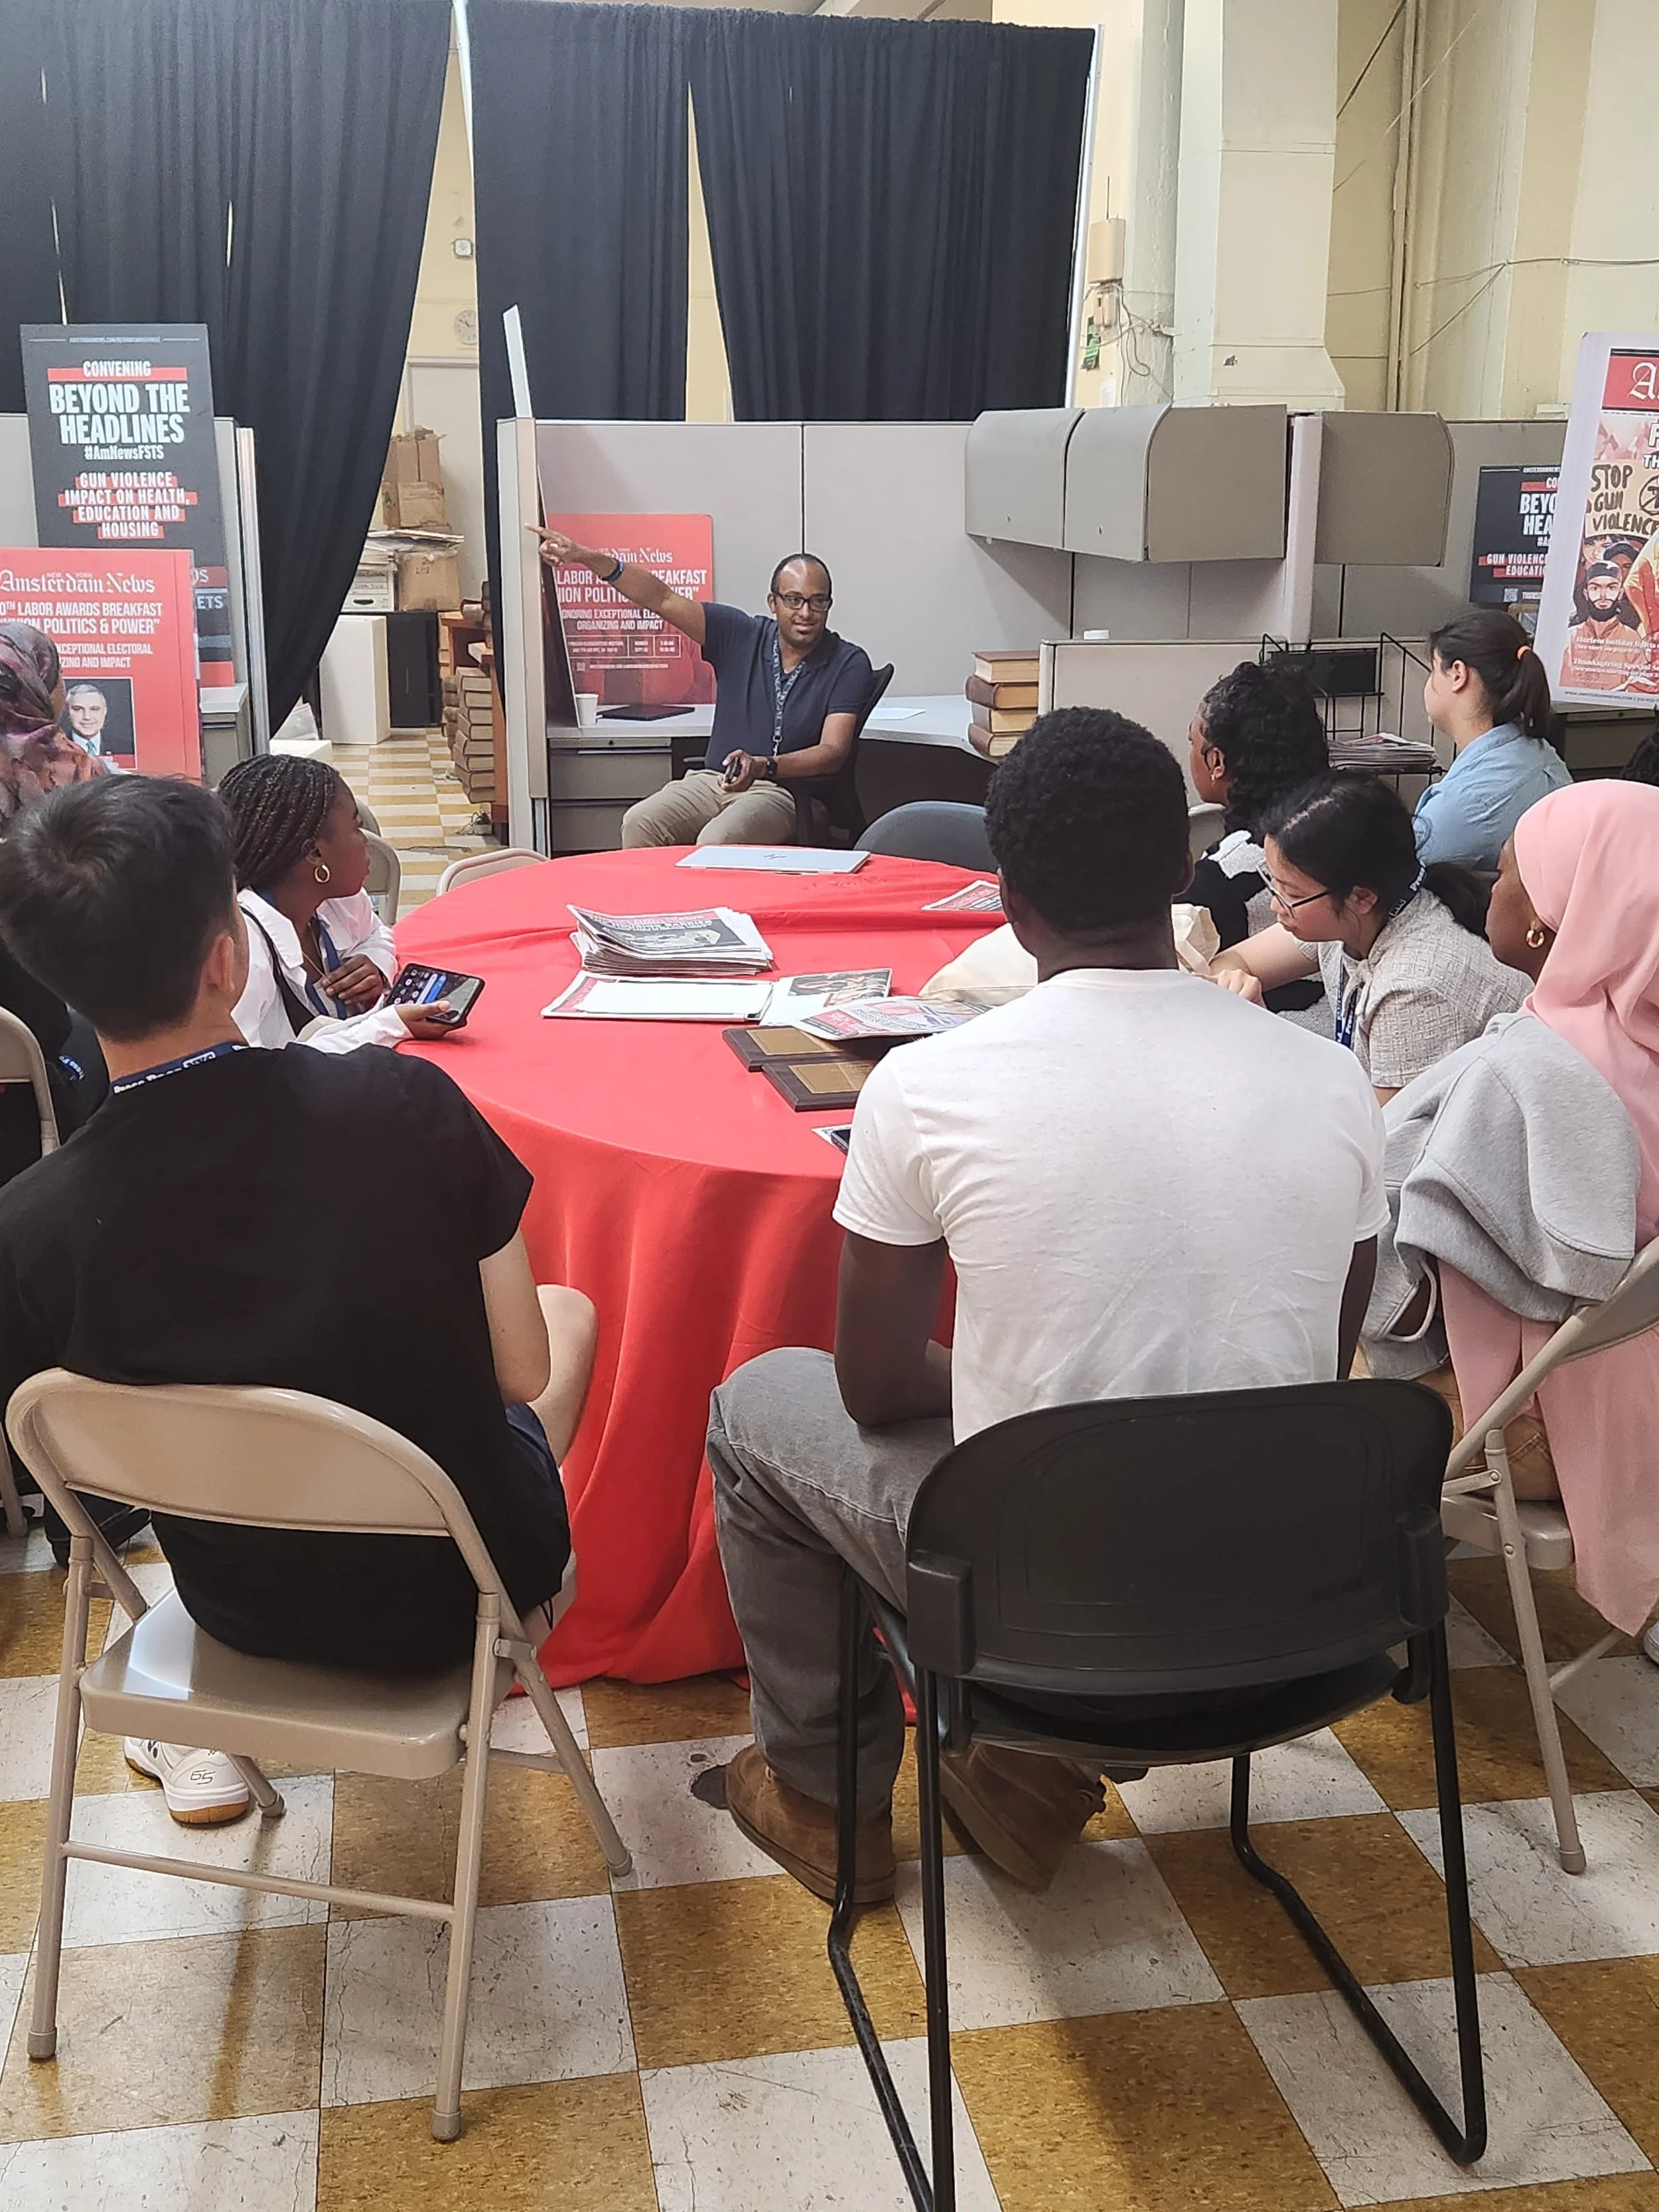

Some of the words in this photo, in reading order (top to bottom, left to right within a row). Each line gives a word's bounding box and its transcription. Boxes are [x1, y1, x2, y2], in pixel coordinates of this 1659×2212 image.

[83, 360, 151, 378] CONVENING
[48, 384, 140, 413] BEYOND
[145, 383, 190, 412] THE
[59, 413, 185, 444] HEADLINES
[84, 445, 165, 460] #AmNewsFSTS
[80, 472, 106, 488] GUN
[110, 471, 173, 488] VIOLENCE
[1591, 464, 1633, 492] STOP
[64, 489, 113, 505] IMPACT
[116, 488, 134, 504] ON
[137, 488, 190, 505] HEALTH,
[1594, 490, 1623, 512] GUN
[77, 506, 149, 521] EDUCATION
[153, 505, 180, 521] AND
[101, 522, 160, 538] HOUSING
[639, 547, 673, 563] News
[1486, 553, 1504, 565] GUN
[0, 569, 104, 593] Amsterdam
[106, 571, 155, 593] News
[557, 570, 593, 585] LABOR
[17, 602, 54, 617] LABOR
[55, 602, 100, 617] AWARDS
[102, 601, 163, 617] BREAKFAST
[594, 609, 642, 619] EXCEPTIONAL
[43, 618, 97, 635] POLITICS
[100, 618, 109, 635] &
[577, 620, 619, 630] ORGANIZING
[620, 620, 636, 630] AND
[637, 619, 663, 630] IMPACT
[108, 642, 154, 654] ELECTORAL
[82, 656, 99, 668] AND
[100, 656, 131, 668] IMPACT
